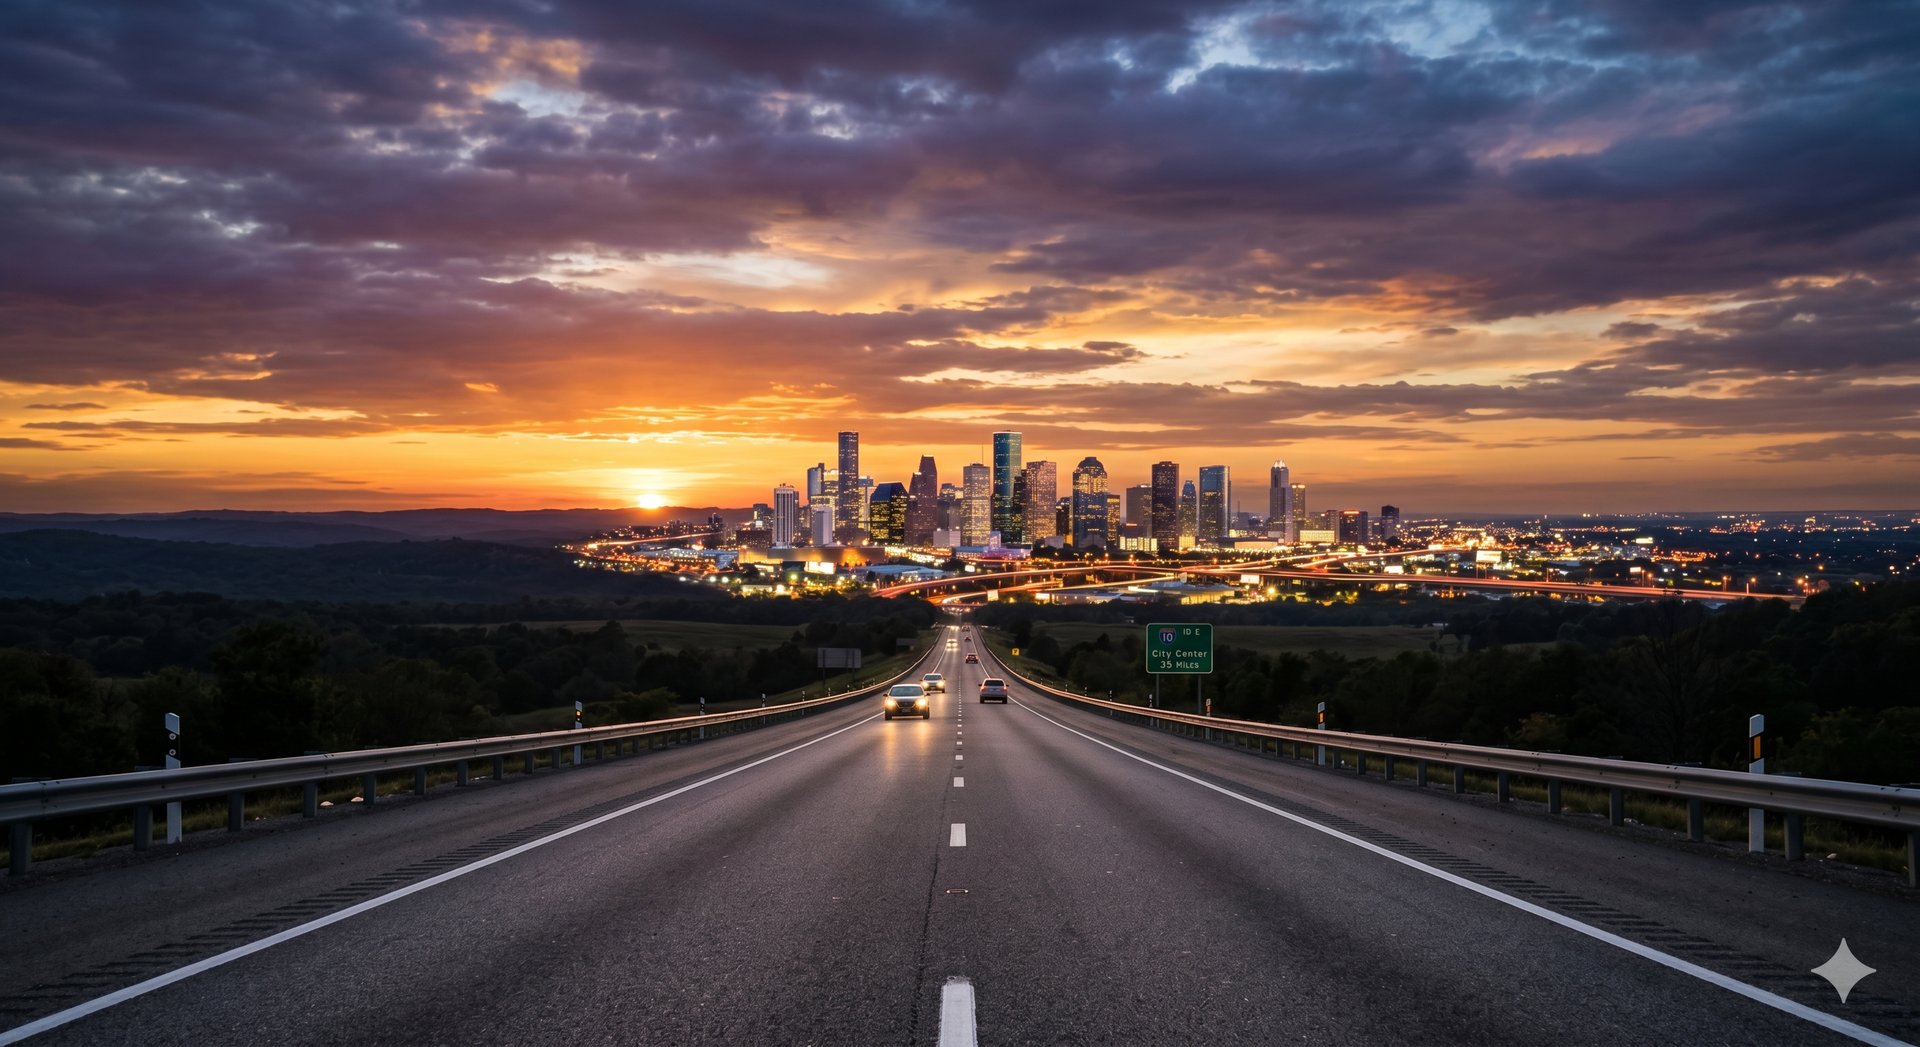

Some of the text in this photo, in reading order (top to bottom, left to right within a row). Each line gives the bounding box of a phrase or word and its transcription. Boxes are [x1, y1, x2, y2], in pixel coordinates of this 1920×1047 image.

[1195, 628, 1200, 636] E
[1163, 633, 1173, 642] 10
[1152, 649, 1207, 659] City Center
[1160, 660, 1173, 669] 35
